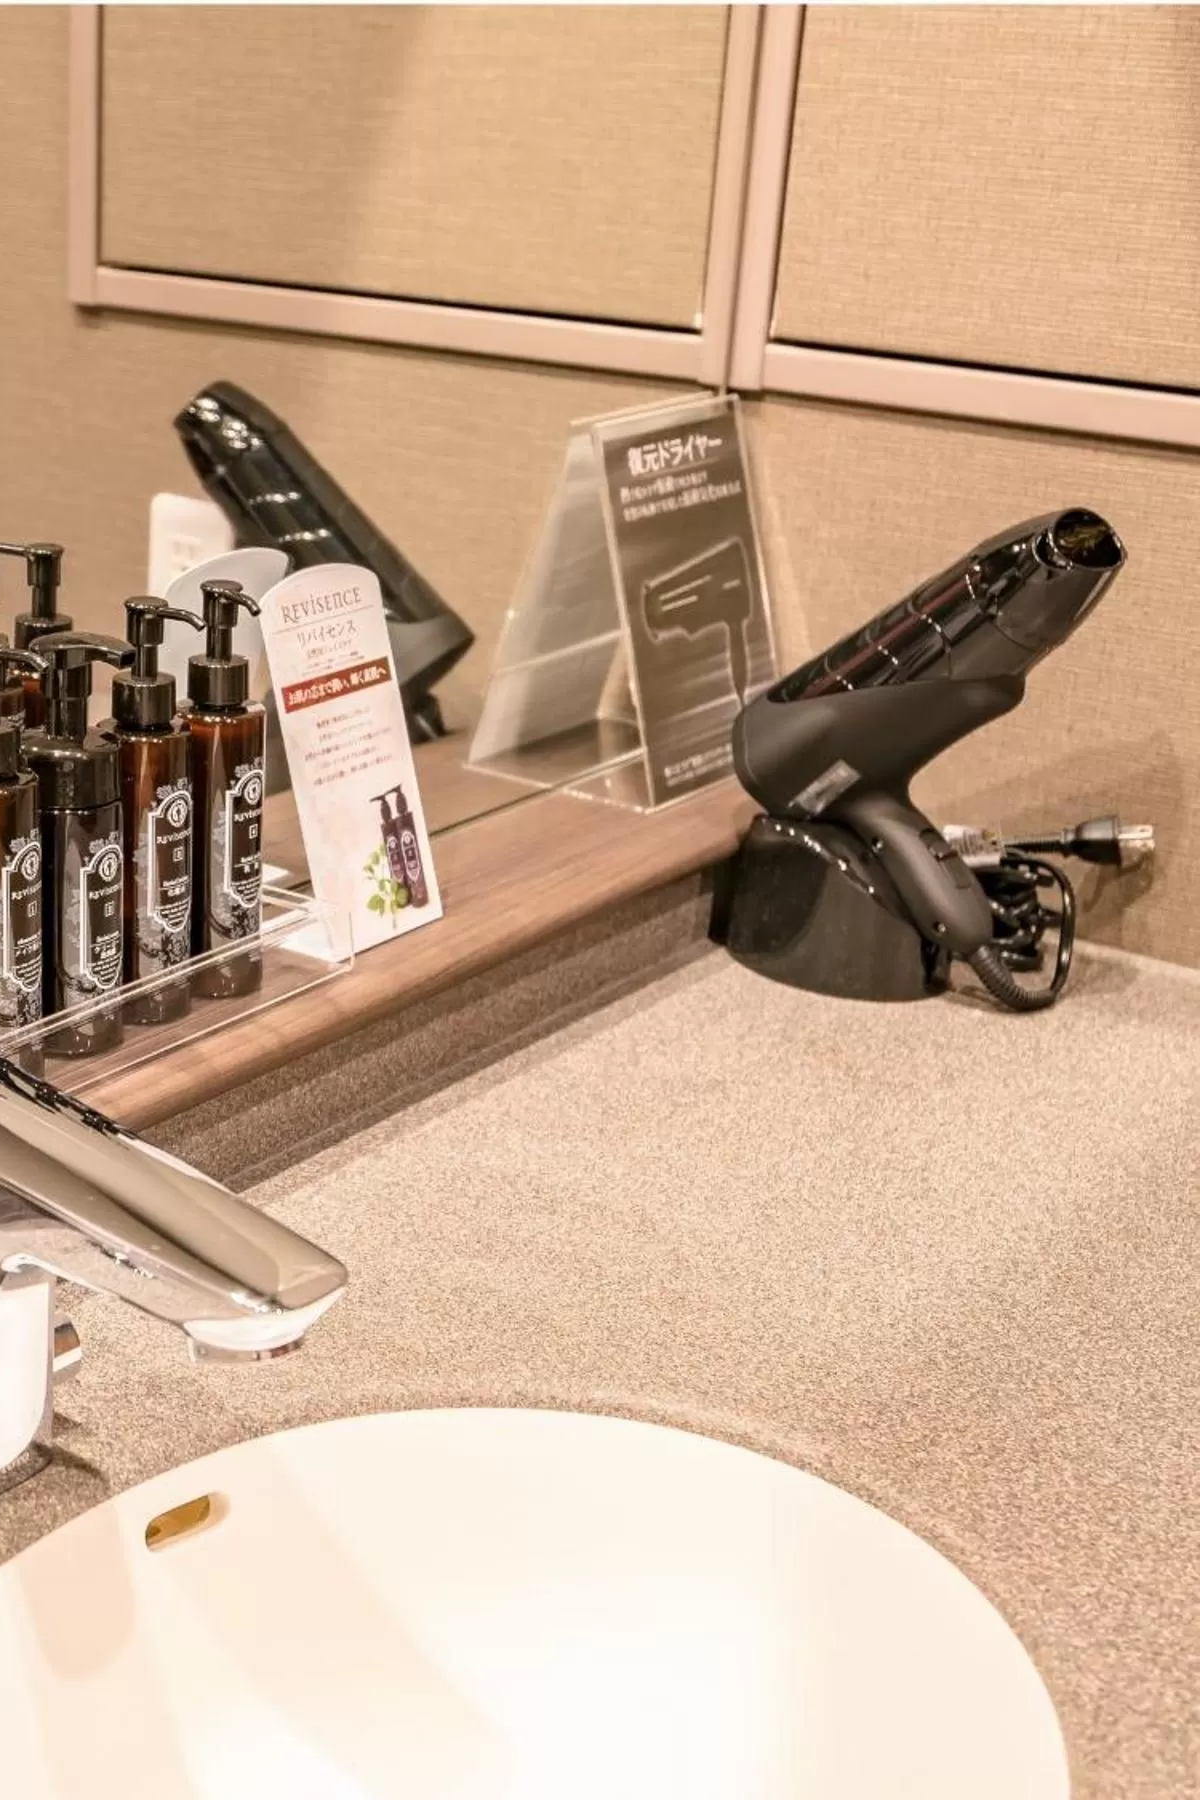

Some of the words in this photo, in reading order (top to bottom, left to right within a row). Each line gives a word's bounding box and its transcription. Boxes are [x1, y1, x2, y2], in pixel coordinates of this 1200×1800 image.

[297, 620, 357, 648] リバイセンス
